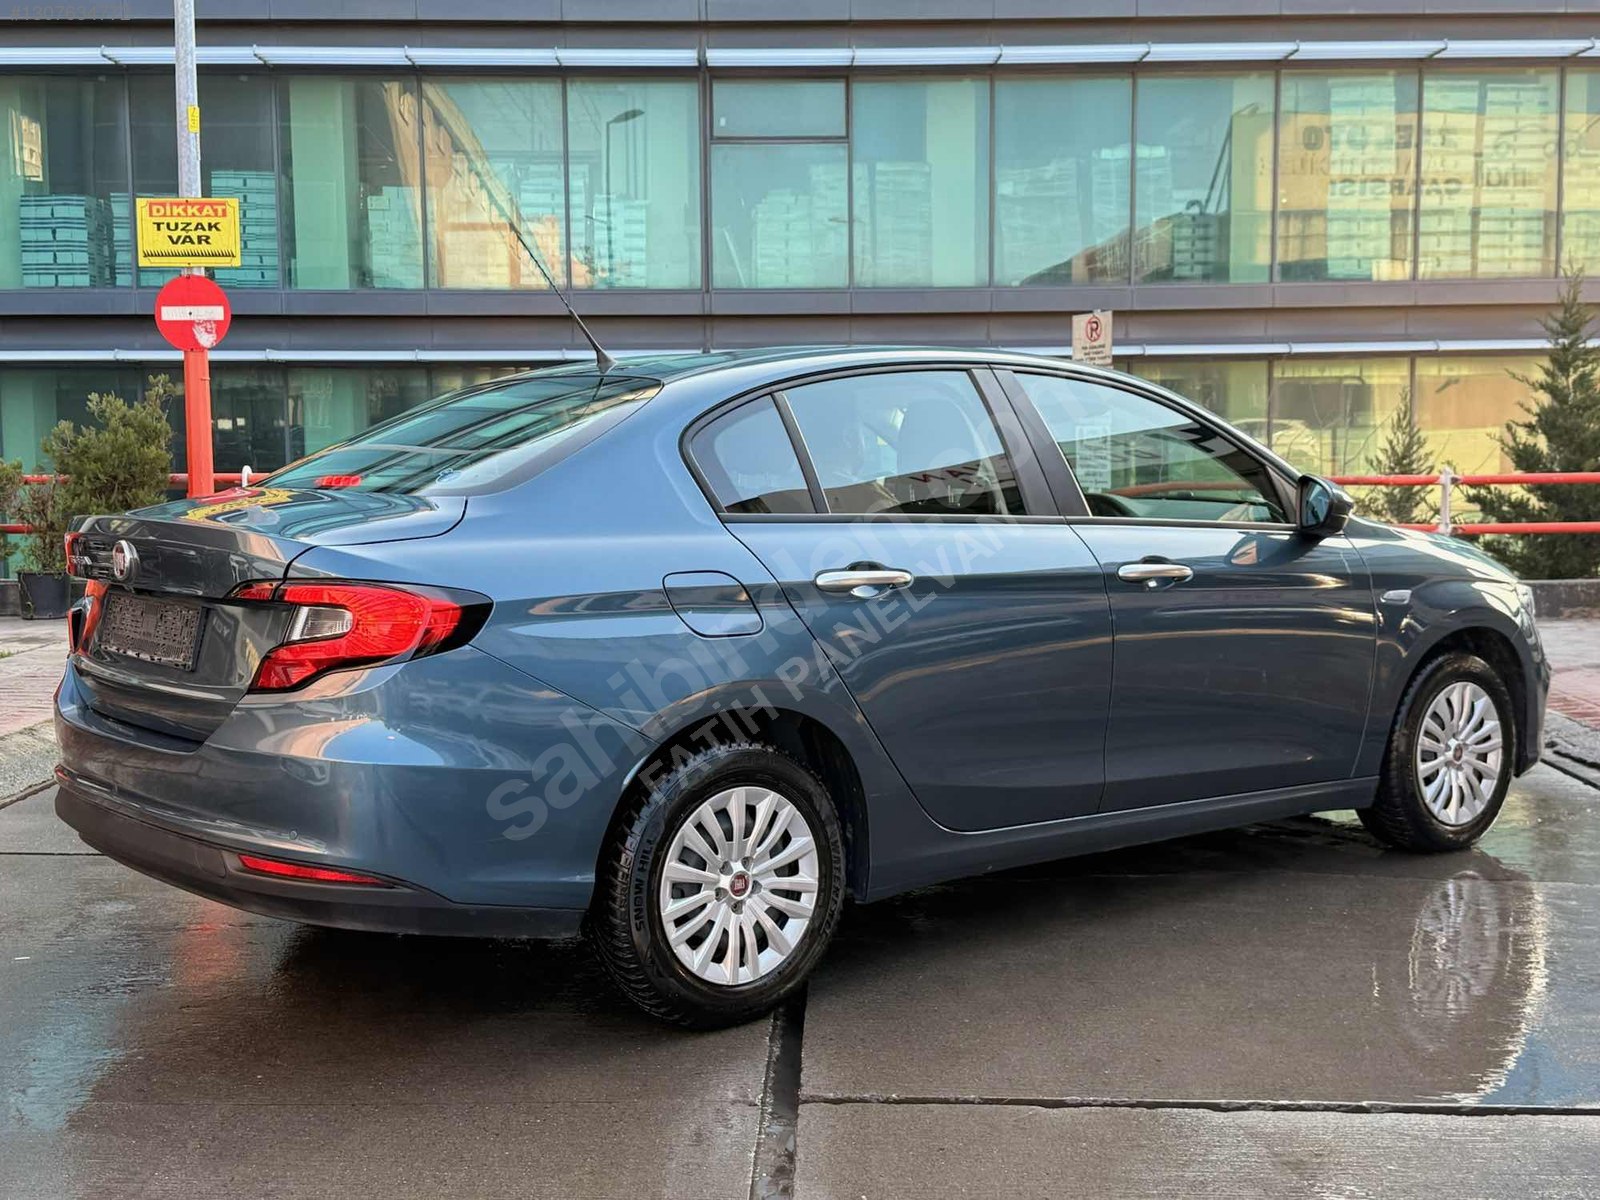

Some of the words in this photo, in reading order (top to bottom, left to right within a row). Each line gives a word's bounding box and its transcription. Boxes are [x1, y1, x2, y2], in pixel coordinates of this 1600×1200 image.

[151, 203, 226, 217] DİKKAT
[152, 222, 221, 232] TUZAK
[167, 235, 212, 245] VAR
